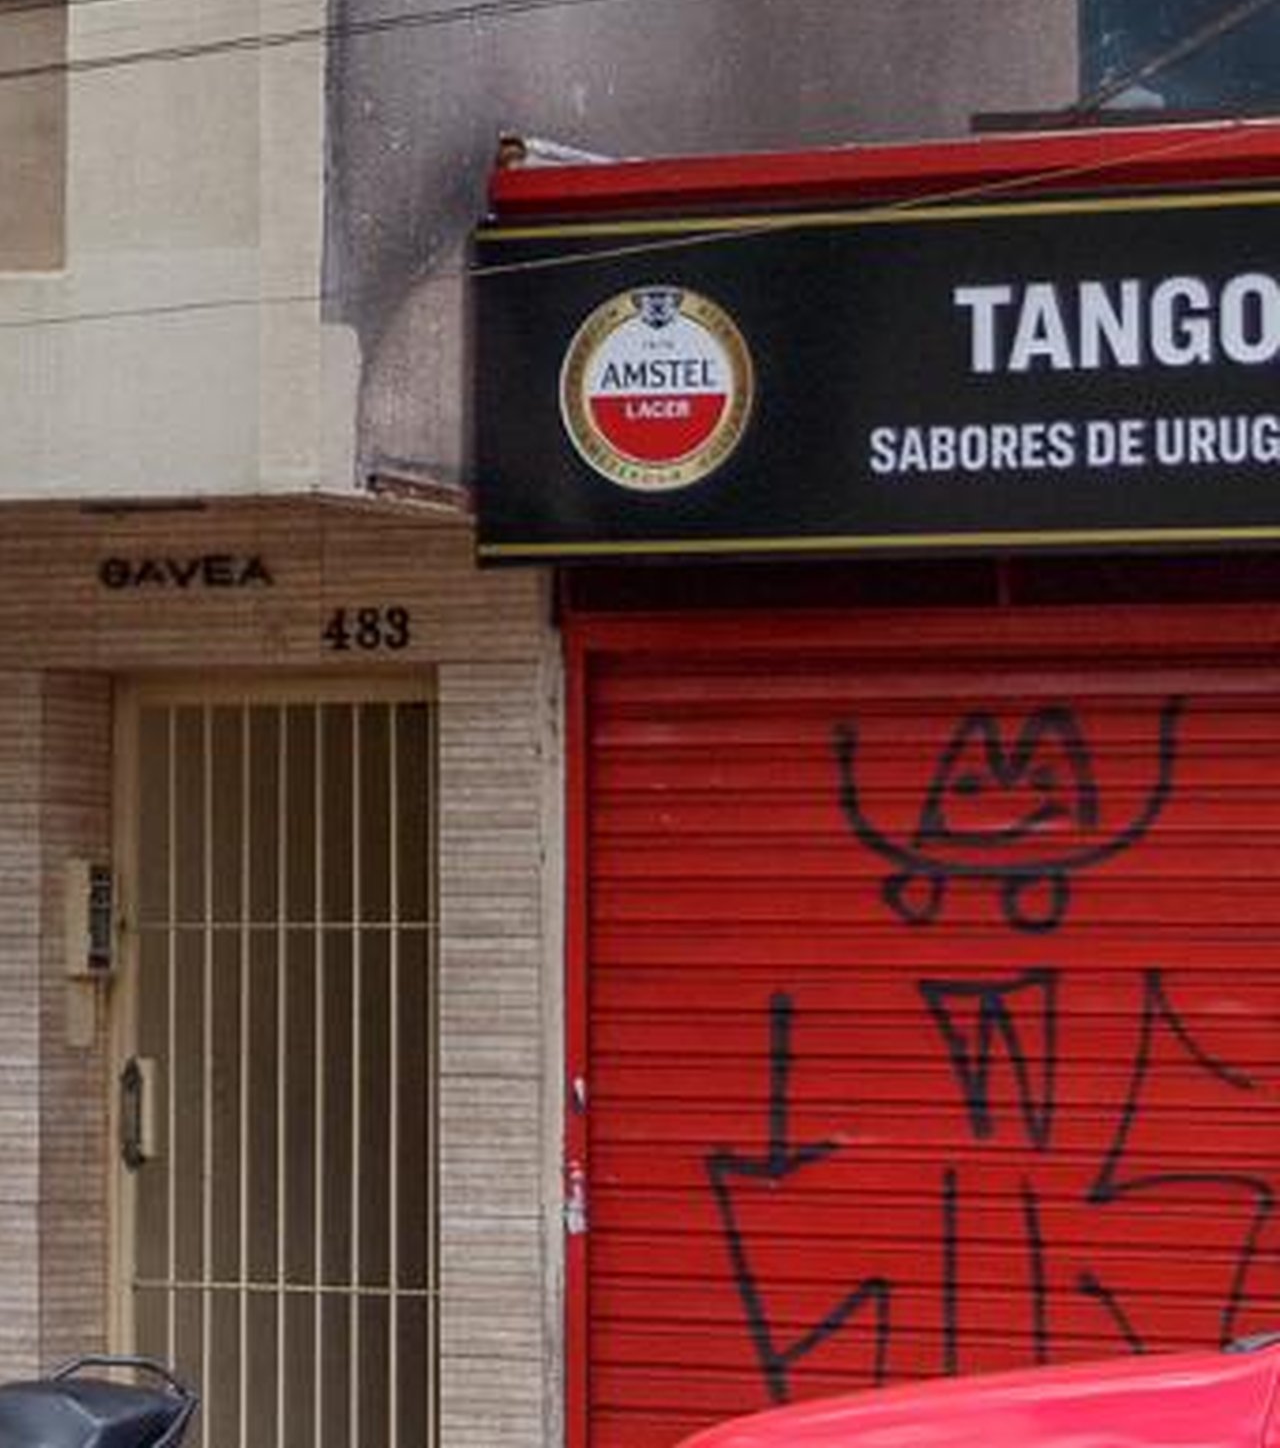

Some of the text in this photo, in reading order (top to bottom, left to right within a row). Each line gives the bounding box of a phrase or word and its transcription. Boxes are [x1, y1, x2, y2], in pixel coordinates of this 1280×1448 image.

[954, 273, 1280, 372] TANGO
[600, 359, 717, 389] AMSTEL
[625, 399, 691, 420] LAGER
[870, 419, 1075, 472] SABORES
[1086, 419, 1145, 466] DE
[98, 555, 275, 589] GAVEA
[322, 607, 410, 651] 483
